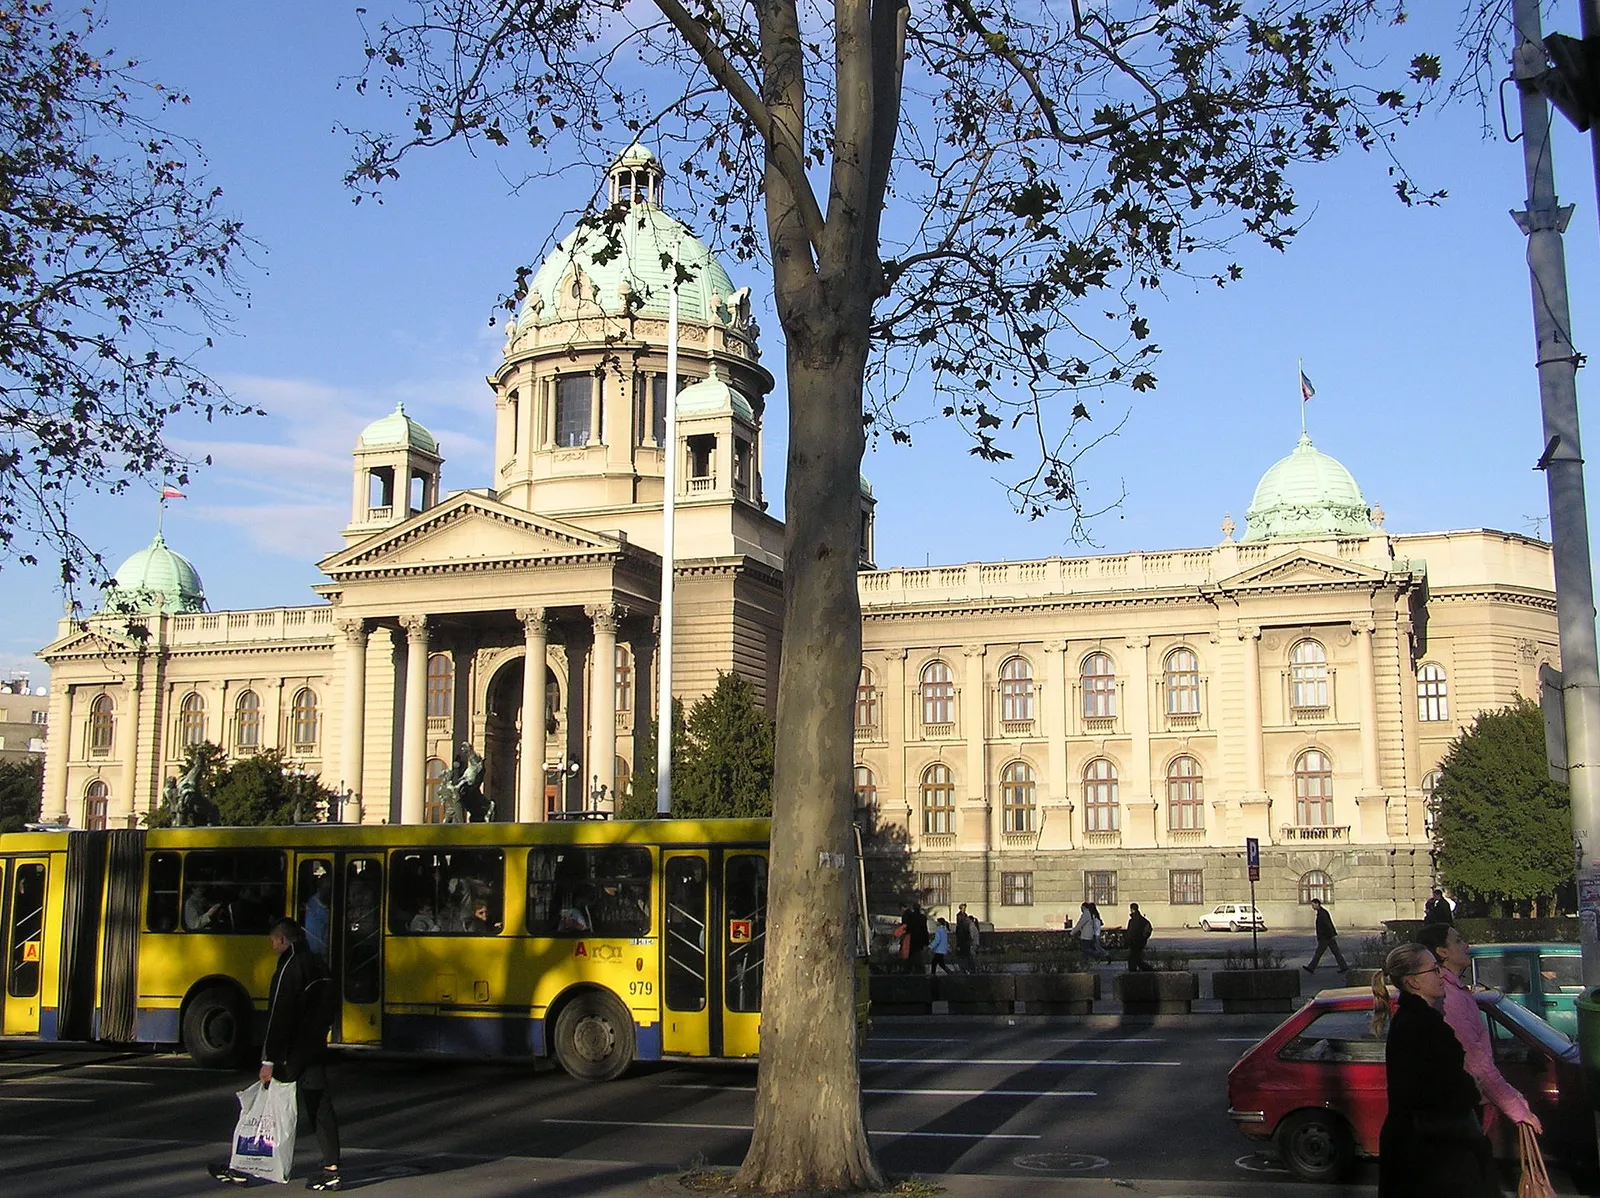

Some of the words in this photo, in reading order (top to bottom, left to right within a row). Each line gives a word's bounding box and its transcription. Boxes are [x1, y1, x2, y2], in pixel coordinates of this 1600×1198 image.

[1250, 841, 1257, 862] P
[27, 944, 37, 957] A
[629, 981, 653, 996] 979
